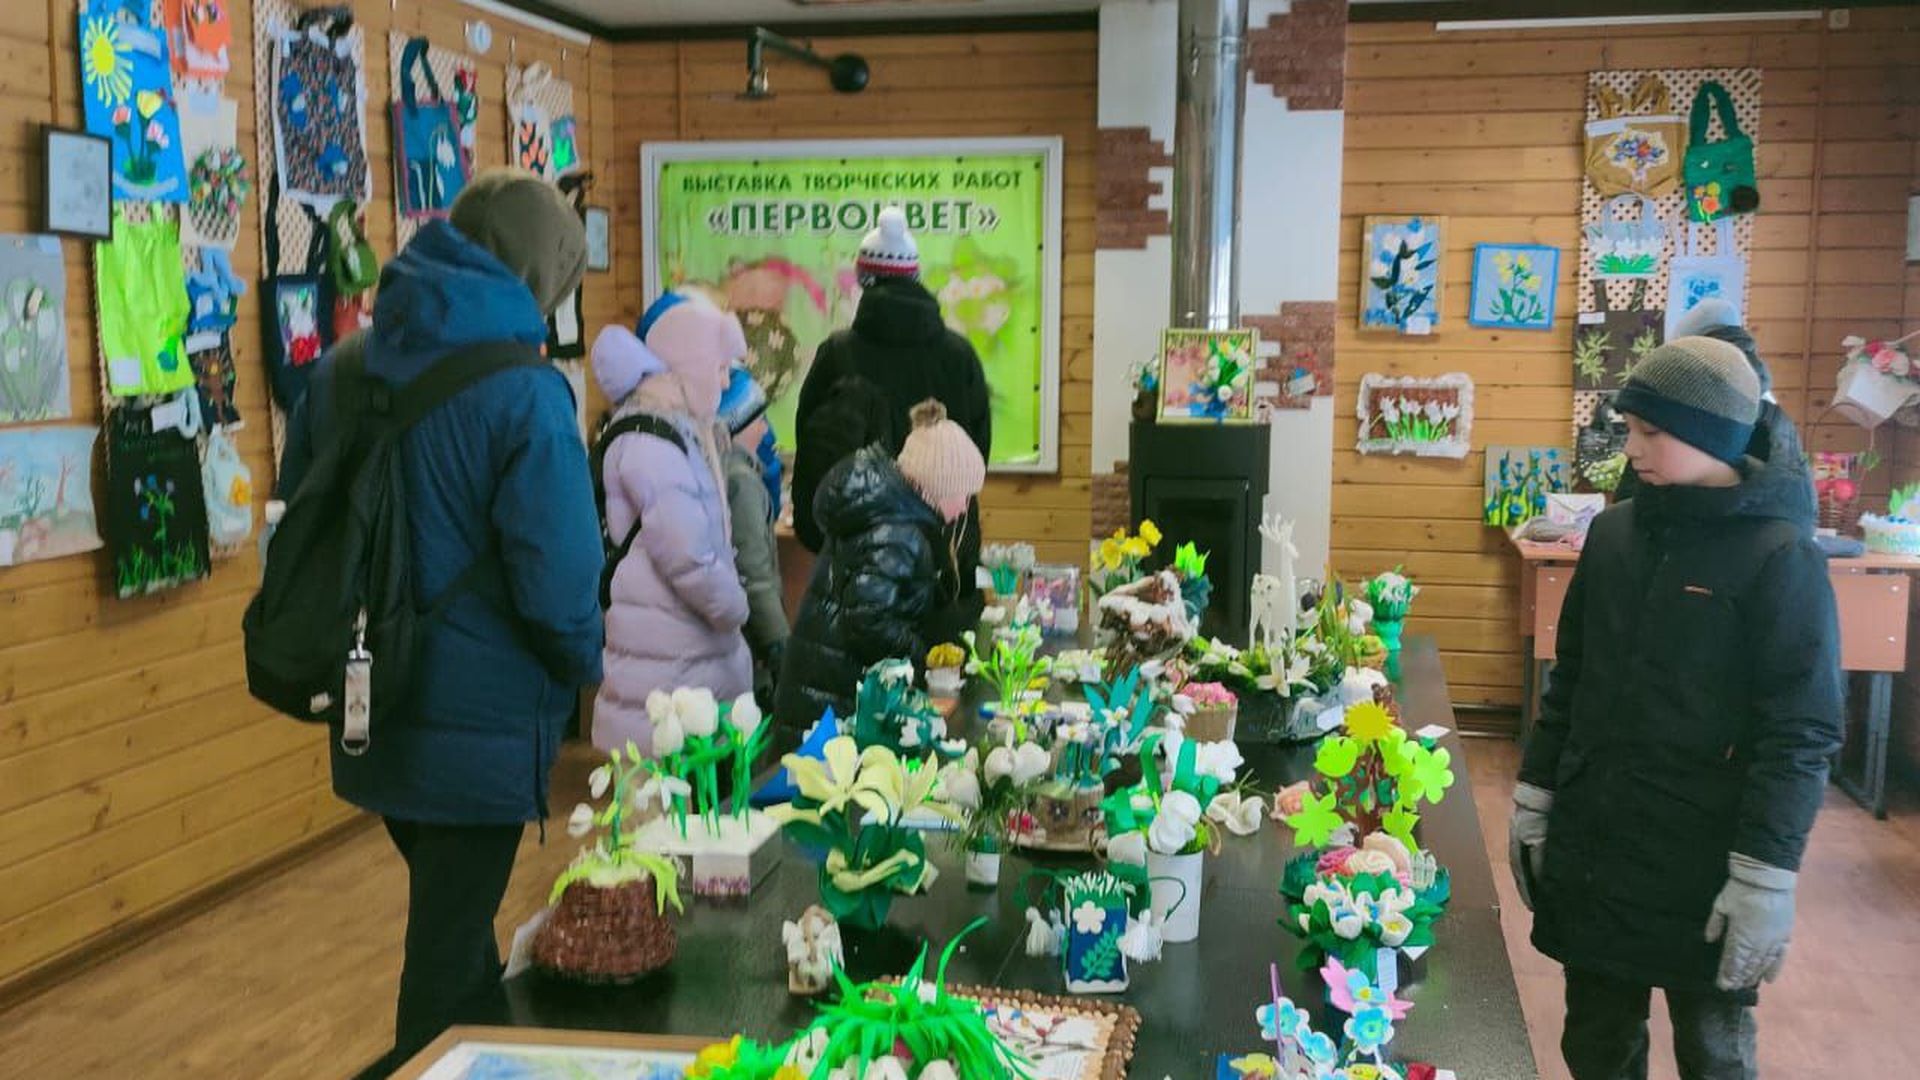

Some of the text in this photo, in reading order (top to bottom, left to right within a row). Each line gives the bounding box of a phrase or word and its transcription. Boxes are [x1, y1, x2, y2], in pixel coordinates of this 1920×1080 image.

[682, 170, 1022, 193] ВЫСТАВКА ТВОРЧЕСКИХ РАБОТ
